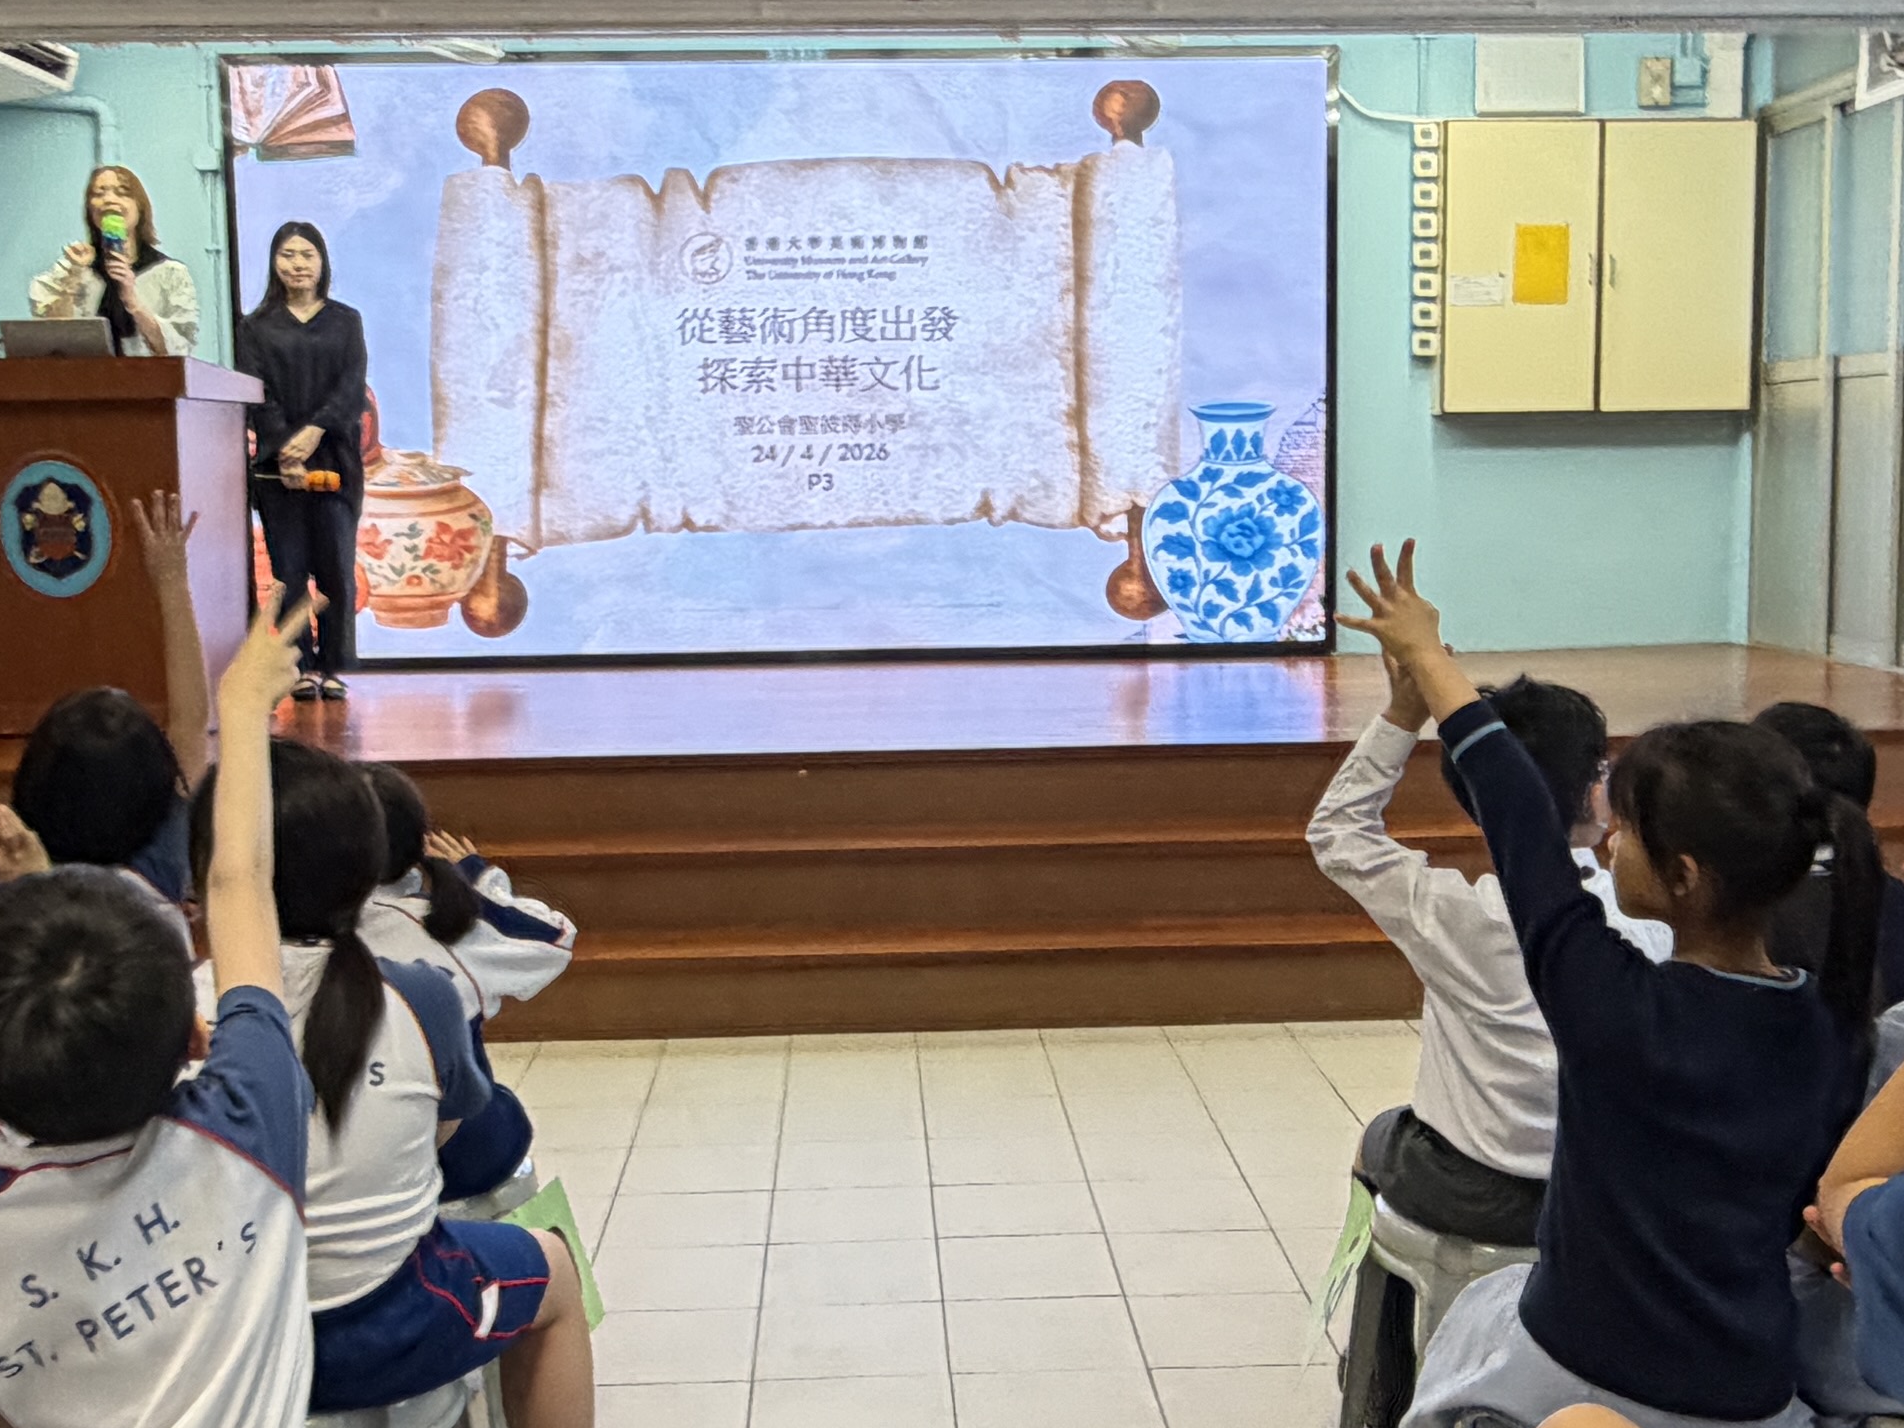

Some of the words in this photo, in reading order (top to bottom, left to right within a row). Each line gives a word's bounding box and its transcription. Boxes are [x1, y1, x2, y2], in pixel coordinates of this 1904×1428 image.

[676, 305, 960, 346] 從藝術角度出發
[697, 354, 941, 394] 探索中華文化
[808, 473, 834, 491] P3
